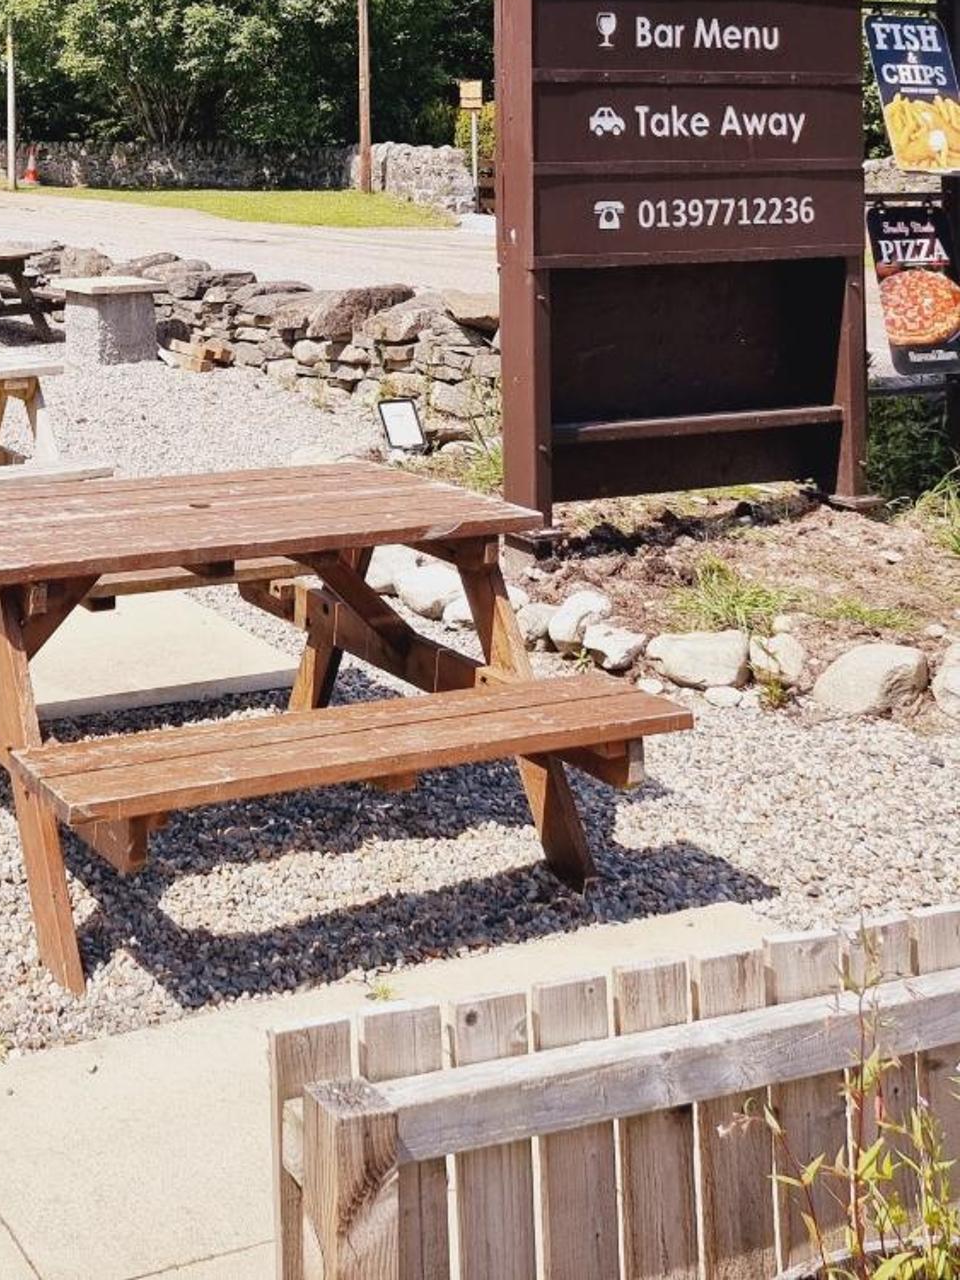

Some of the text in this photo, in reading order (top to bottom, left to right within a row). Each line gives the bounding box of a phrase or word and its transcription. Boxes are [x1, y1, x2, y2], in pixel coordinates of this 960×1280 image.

[635, 16, 780, 51] Bar Menu
[871, 23, 942, 52] FISH
[907, 52, 918, 64] &
[881, 63, 948, 87] CHIPS
[635, 104, 806, 144] Take Away
[638, 195, 815, 229] 01397712236
[878, 238, 950, 263] PIZZA
